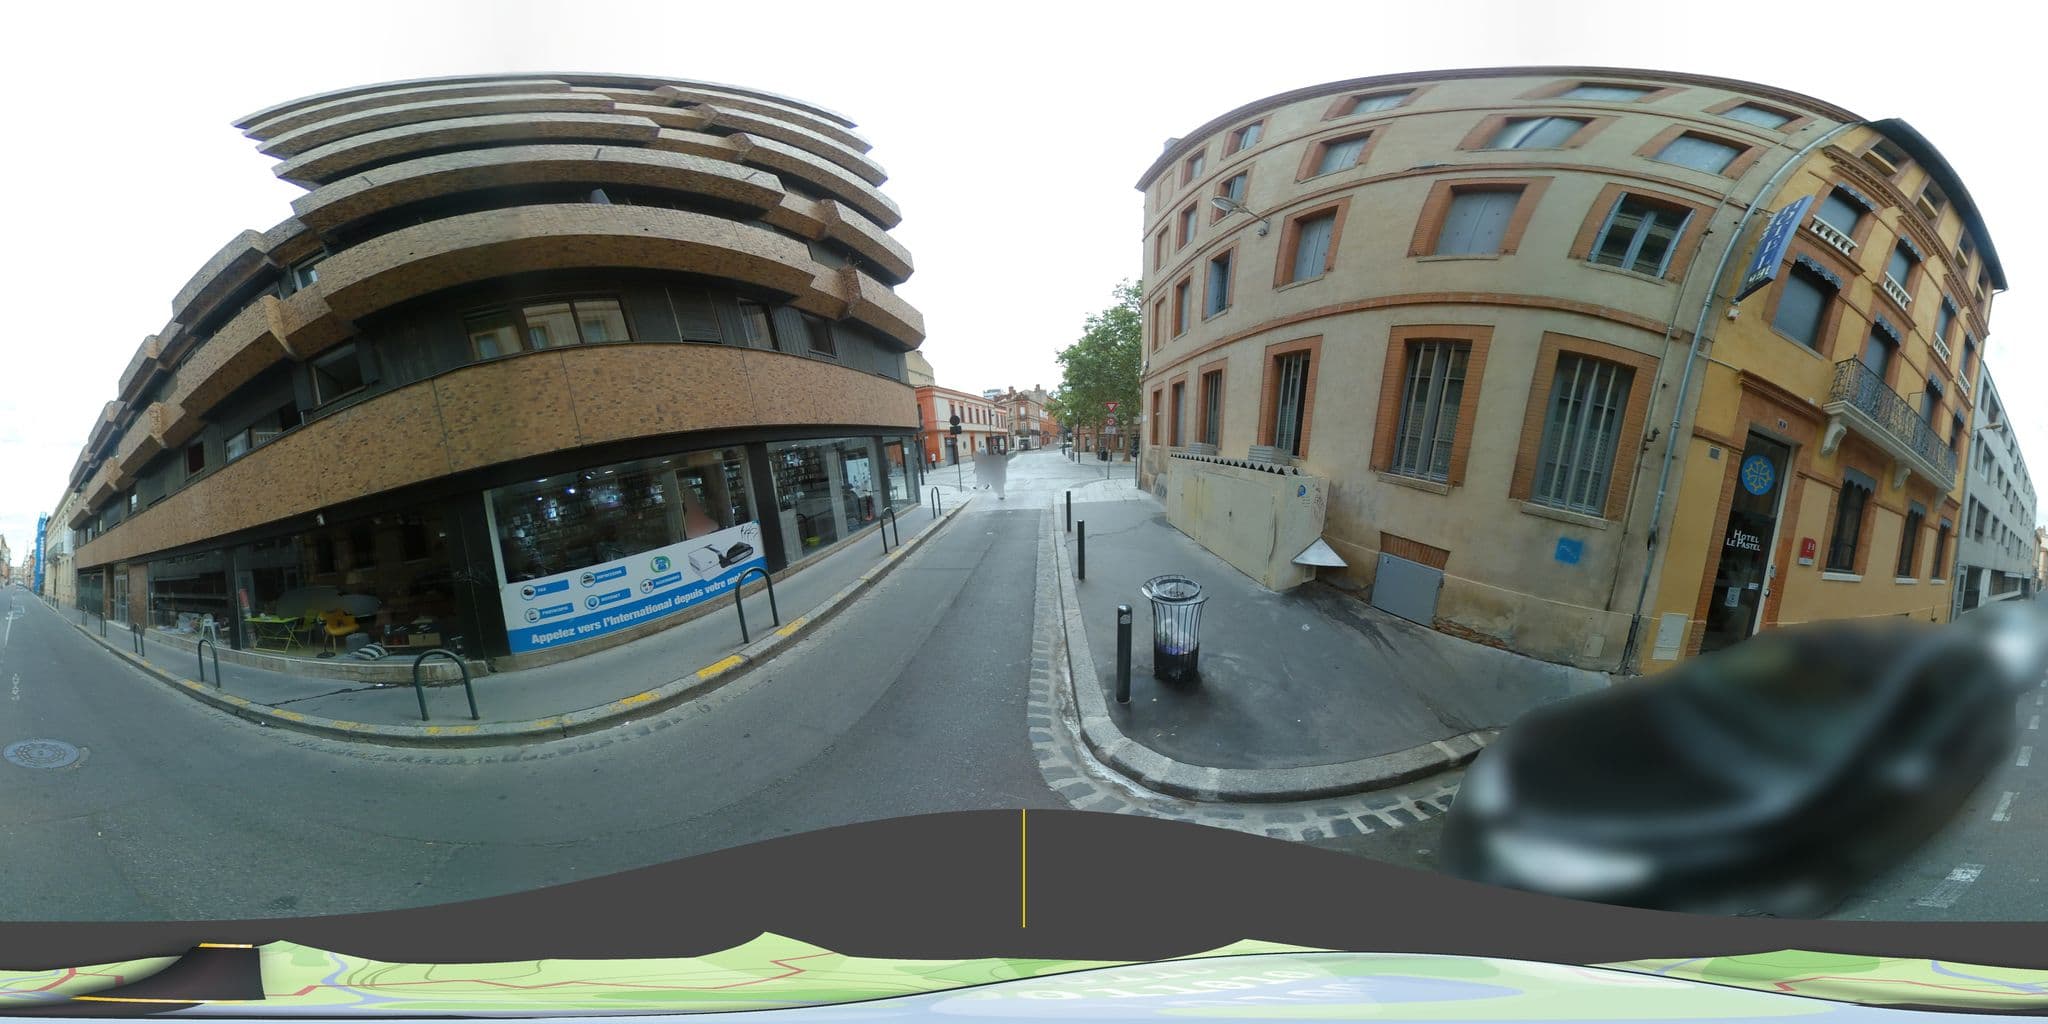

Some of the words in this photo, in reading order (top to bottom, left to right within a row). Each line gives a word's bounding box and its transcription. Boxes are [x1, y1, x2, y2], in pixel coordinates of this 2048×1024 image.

[1726, 537, 1736, 547] LE
[1736, 538, 1761, 551] PASTEL
[531, 627, 576, 644] Appelez
[577, 621, 602, 634] vers
[674, 588, 704, 606] depuis
[704, 582, 726, 594] votre
